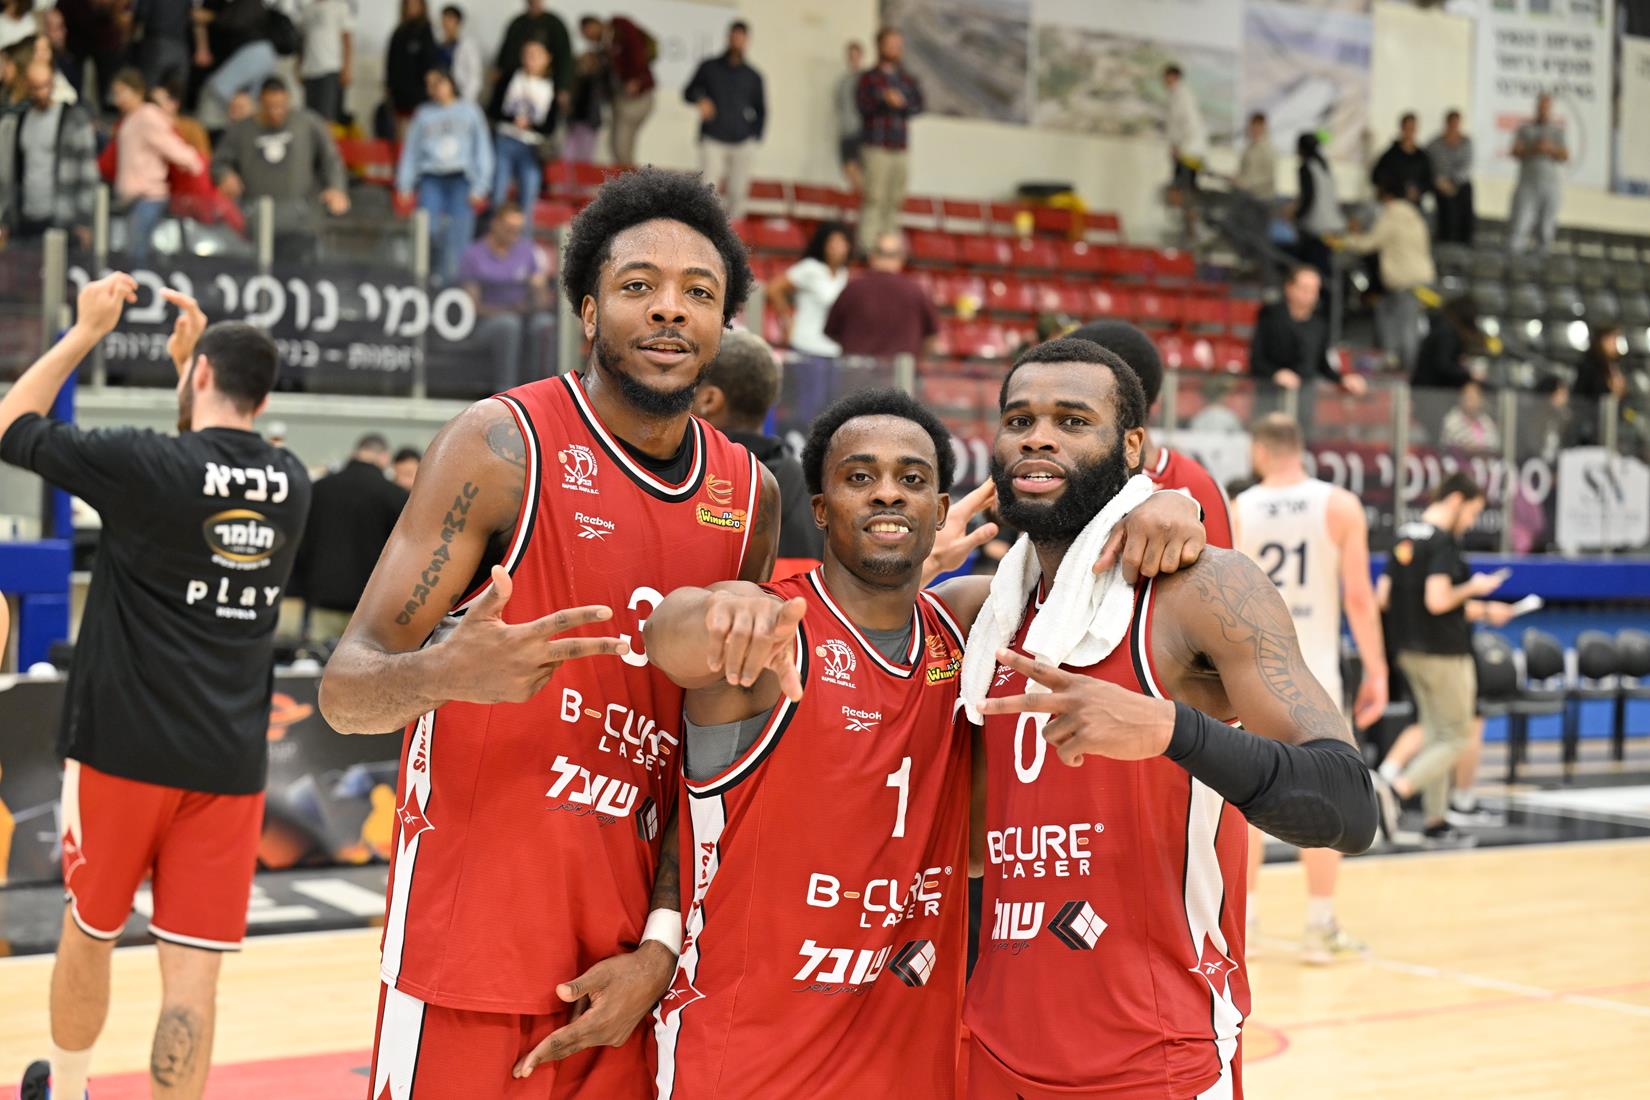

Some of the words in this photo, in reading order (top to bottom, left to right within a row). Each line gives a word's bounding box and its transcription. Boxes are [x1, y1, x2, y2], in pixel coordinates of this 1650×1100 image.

[215, 273, 339, 332] נופי
[359, 282, 476, 342] סמי
[203, 462, 288, 503] לביא
[214, 520, 274, 548] תומר
[574, 512, 615, 530] Reebok
[1258, 540, 1306, 588] 21
[619, 586, 665, 667] 3
[841, 706, 882, 720] Reebok
[1014, 711, 1052, 783] 0
[545, 755, 639, 818] שובל
[886, 757, 911, 838] 1
[1002, 859, 1091, 879] LASER
[793, 939, 893, 985] שובל
